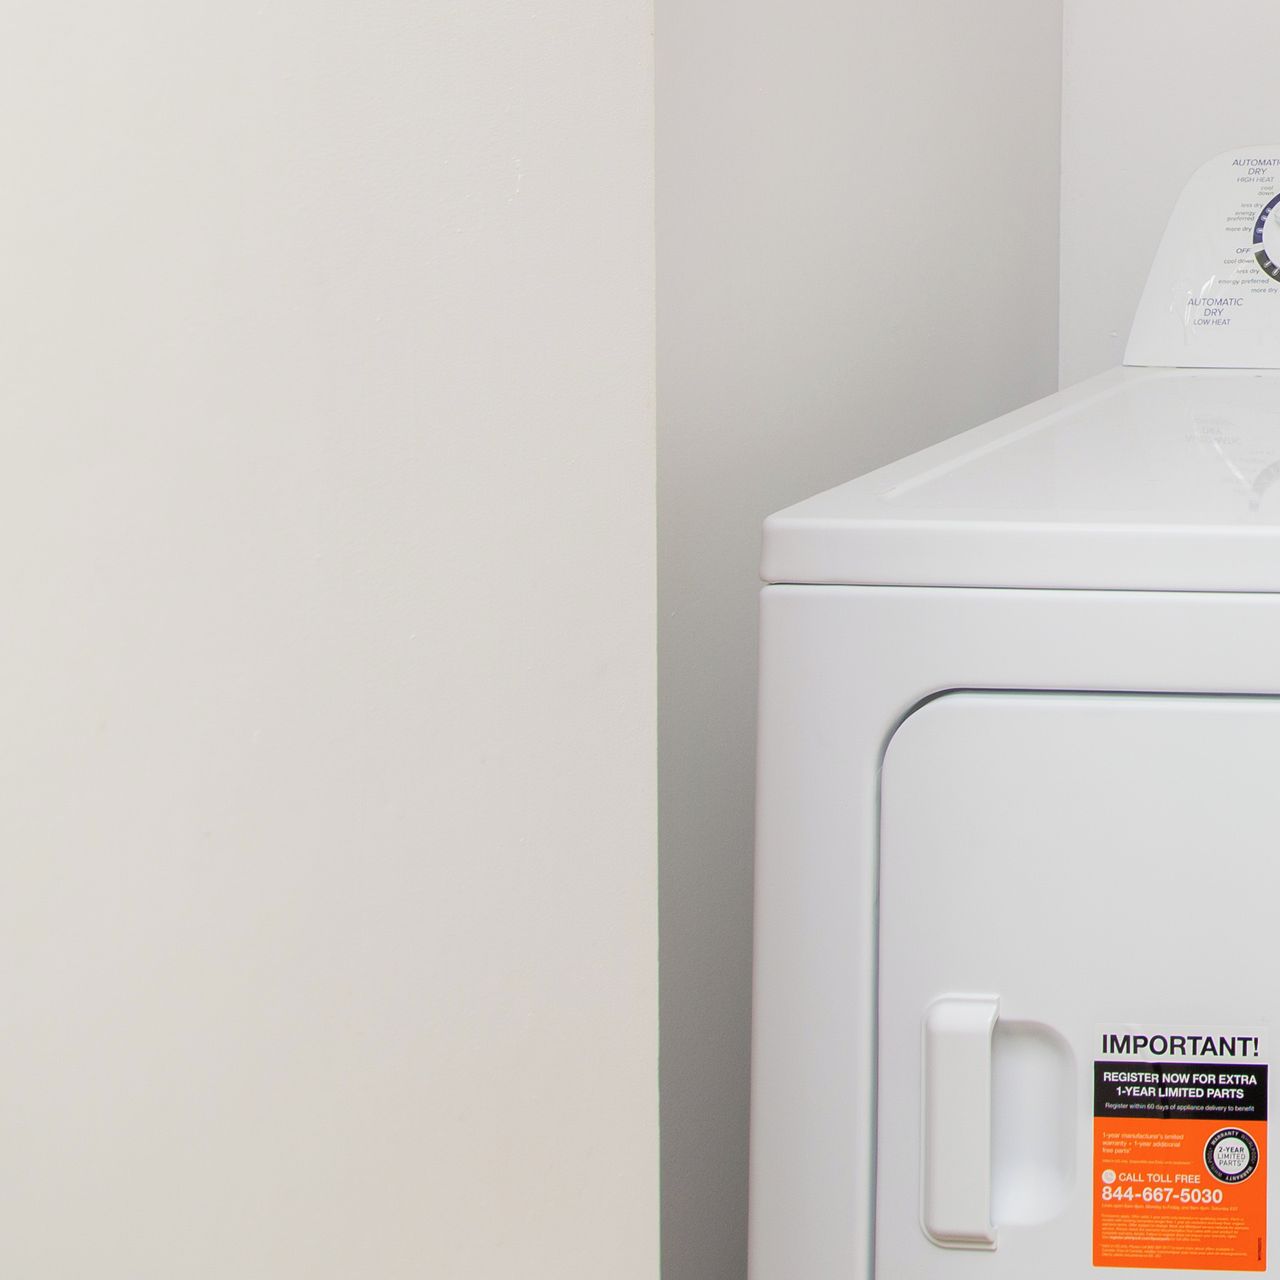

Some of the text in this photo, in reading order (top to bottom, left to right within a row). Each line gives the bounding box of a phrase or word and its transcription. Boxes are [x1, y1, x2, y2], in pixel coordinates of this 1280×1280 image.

[1247, 167, 1268, 175] DRY
[1187, 297, 1244, 307] AUTOMATIC
[1203, 308, 1224, 317] DRY
[1193, 318, 1231, 326] LOW HEAT
[1102, 1034, 1259, 1057] IMPORTANT!
[1103, 1072, 1258, 1085] REGISTER NOW FOR EXTRA
[1116, 1086, 1245, 1099] 1-YEAR LIMITED PARTS
[1104, 1102, 1129, 1110] Register
[1155, 1103, 1169, 1112] days
[1169, 1103, 1177, 1111] of
[1176, 1104, 1204, 1112] appliance
[1204, 1104, 1228, 1113] delivery
[1210, 1130, 1239, 1146] WARRANTY
[1118, 1172, 1201, 1184] CALL TOLL FREE
[1101, 1185, 1223, 1204] 844-667-5030
